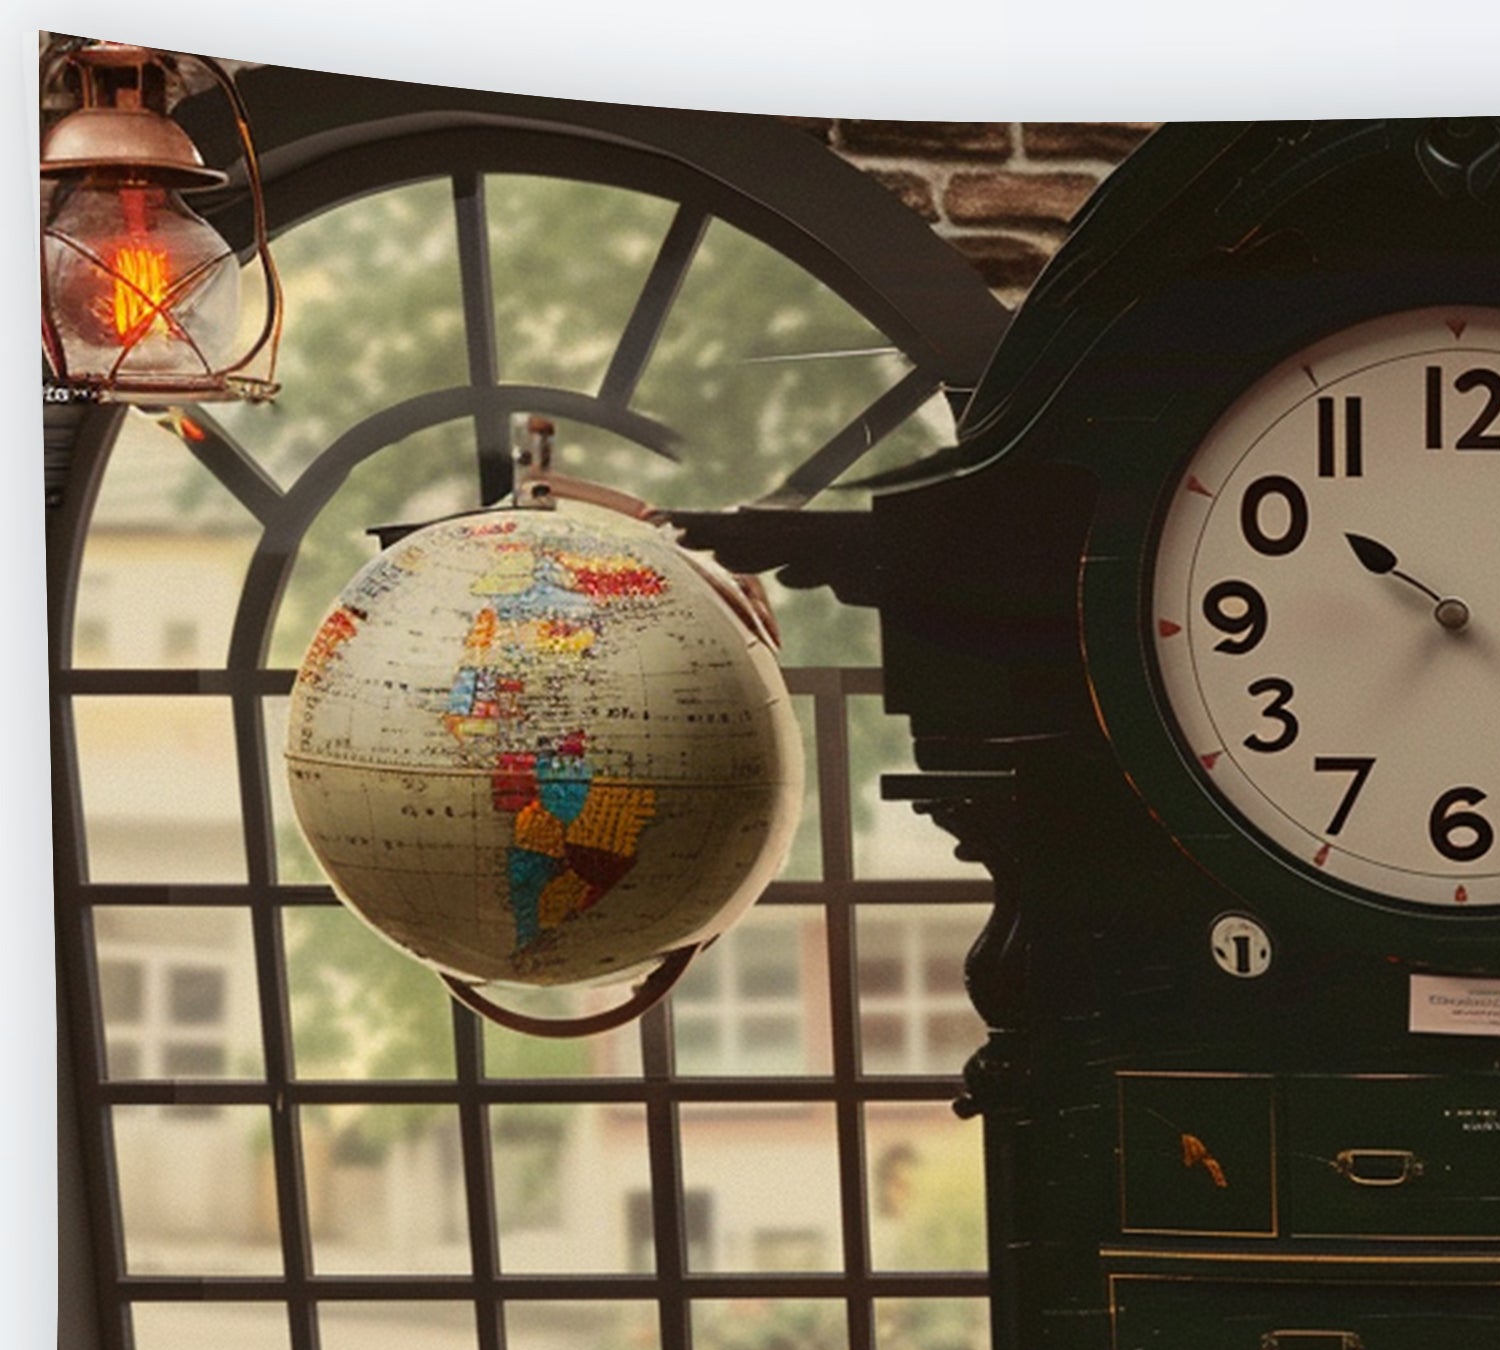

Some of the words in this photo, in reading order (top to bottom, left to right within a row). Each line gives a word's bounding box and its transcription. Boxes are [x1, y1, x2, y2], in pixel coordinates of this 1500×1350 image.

[1317, 396, 1363, 478] 11
[1240, 475, 1309, 557] 0
[1202, 580, 1268, 655] 9
[1243, 677, 1299, 753] 3
[1314, 757, 1377, 836] 7
[1428, 786, 1494, 863] 6
